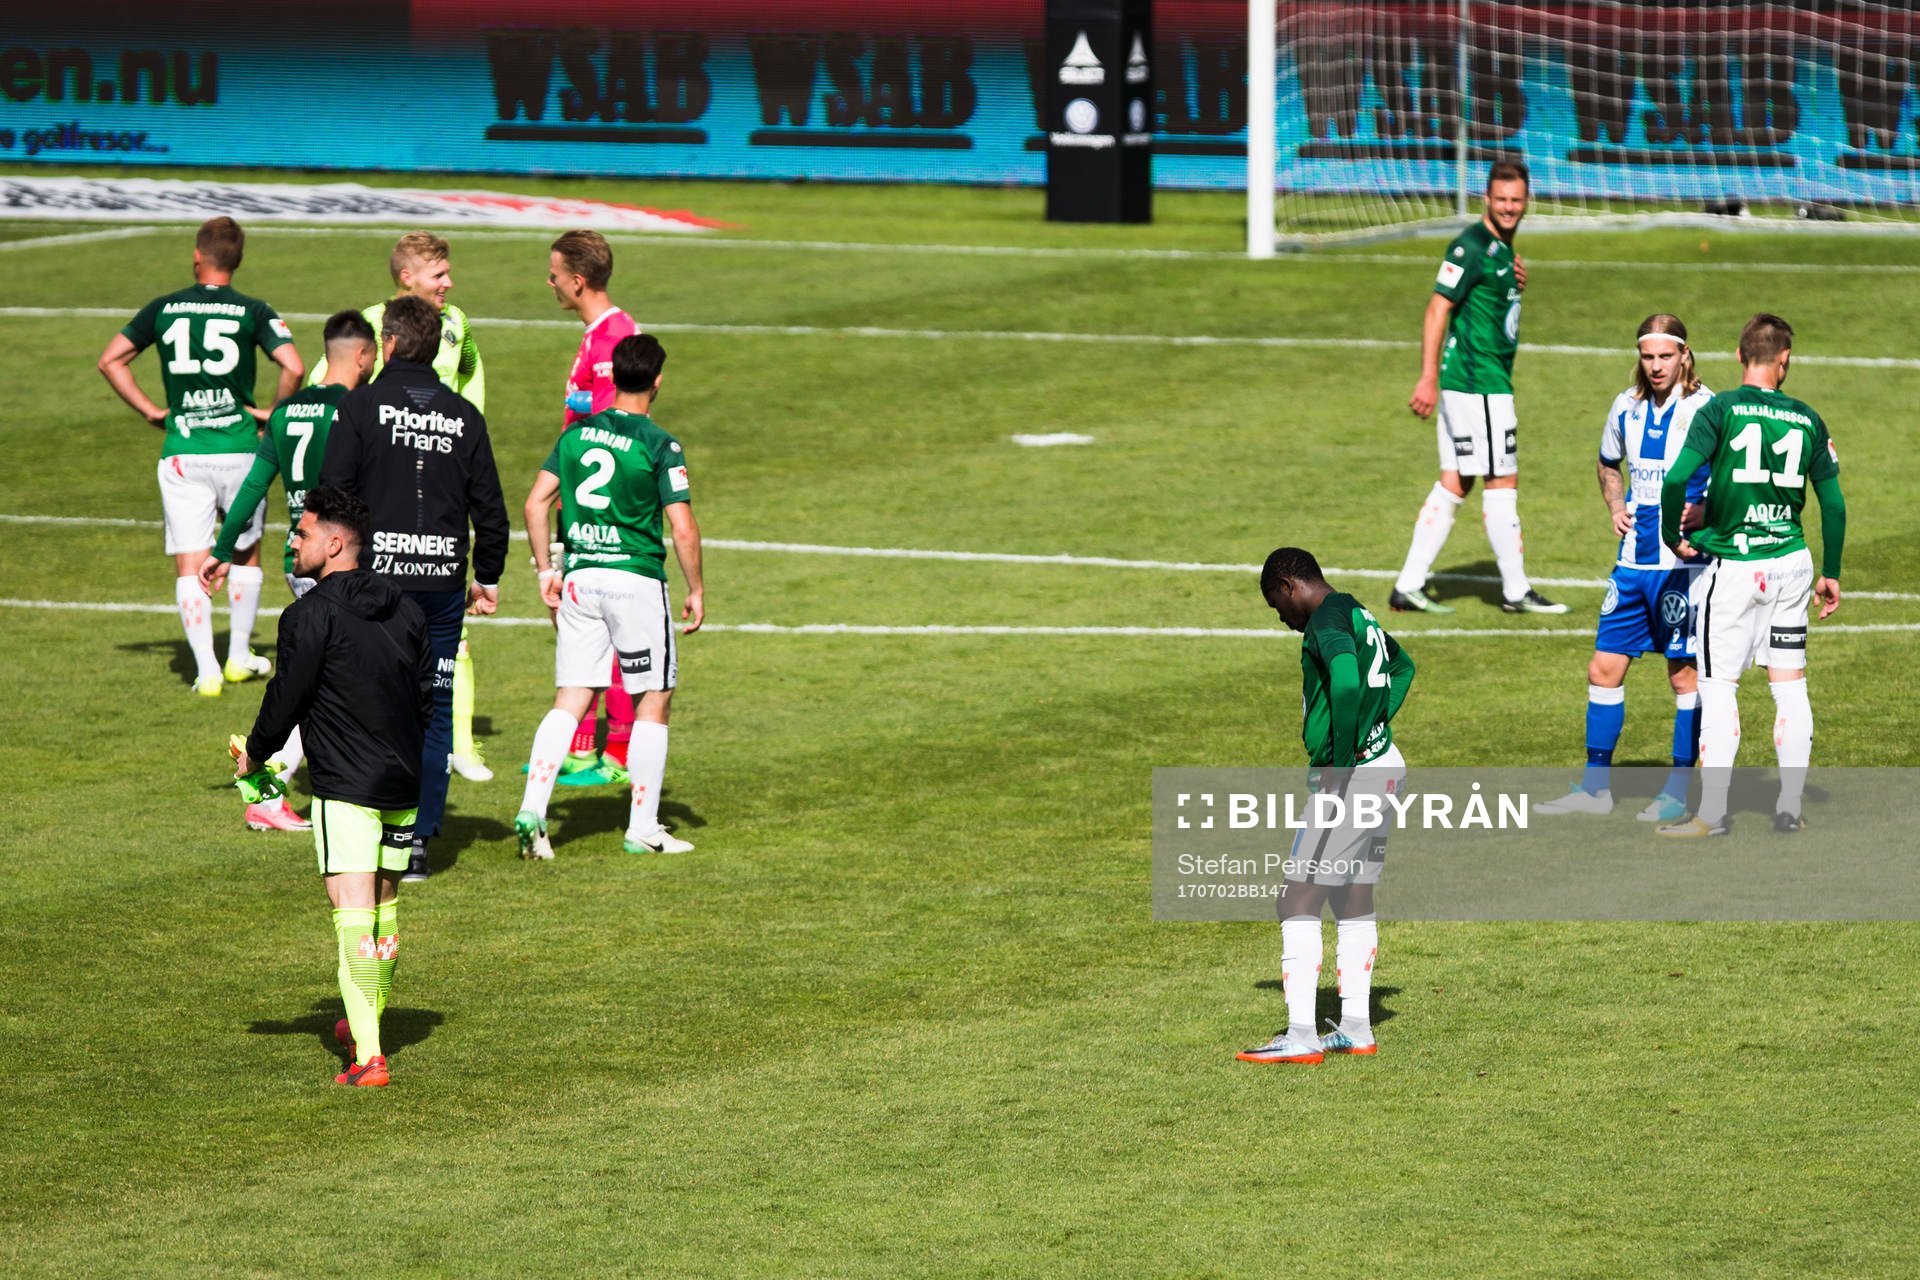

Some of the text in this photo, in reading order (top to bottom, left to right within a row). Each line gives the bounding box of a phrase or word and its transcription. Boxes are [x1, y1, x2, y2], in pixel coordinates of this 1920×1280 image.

[483, 30, 711, 122] WSAB
[748, 34, 977, 128] WSAB
[163, 303, 246, 317] AASMUNDSEN
[162, 318, 240, 376] 15
[182, 388, 235, 409] AQUA
[285, 403, 325, 418] KOZICA
[379, 405, 465, 438] Prioritet
[286, 421, 314, 482] 7
[580, 427, 632, 452] TAMIMI
[1729, 423, 1804, 488] 11
[575, 448, 616, 510] 2
[1744, 504, 1792, 523] AQUA
[372, 531, 456, 557] SERNEKE
[567, 522, 622, 544] AQUA
[372, 554, 459, 576] El KONTAKT
[437, 657, 455, 672] NR
